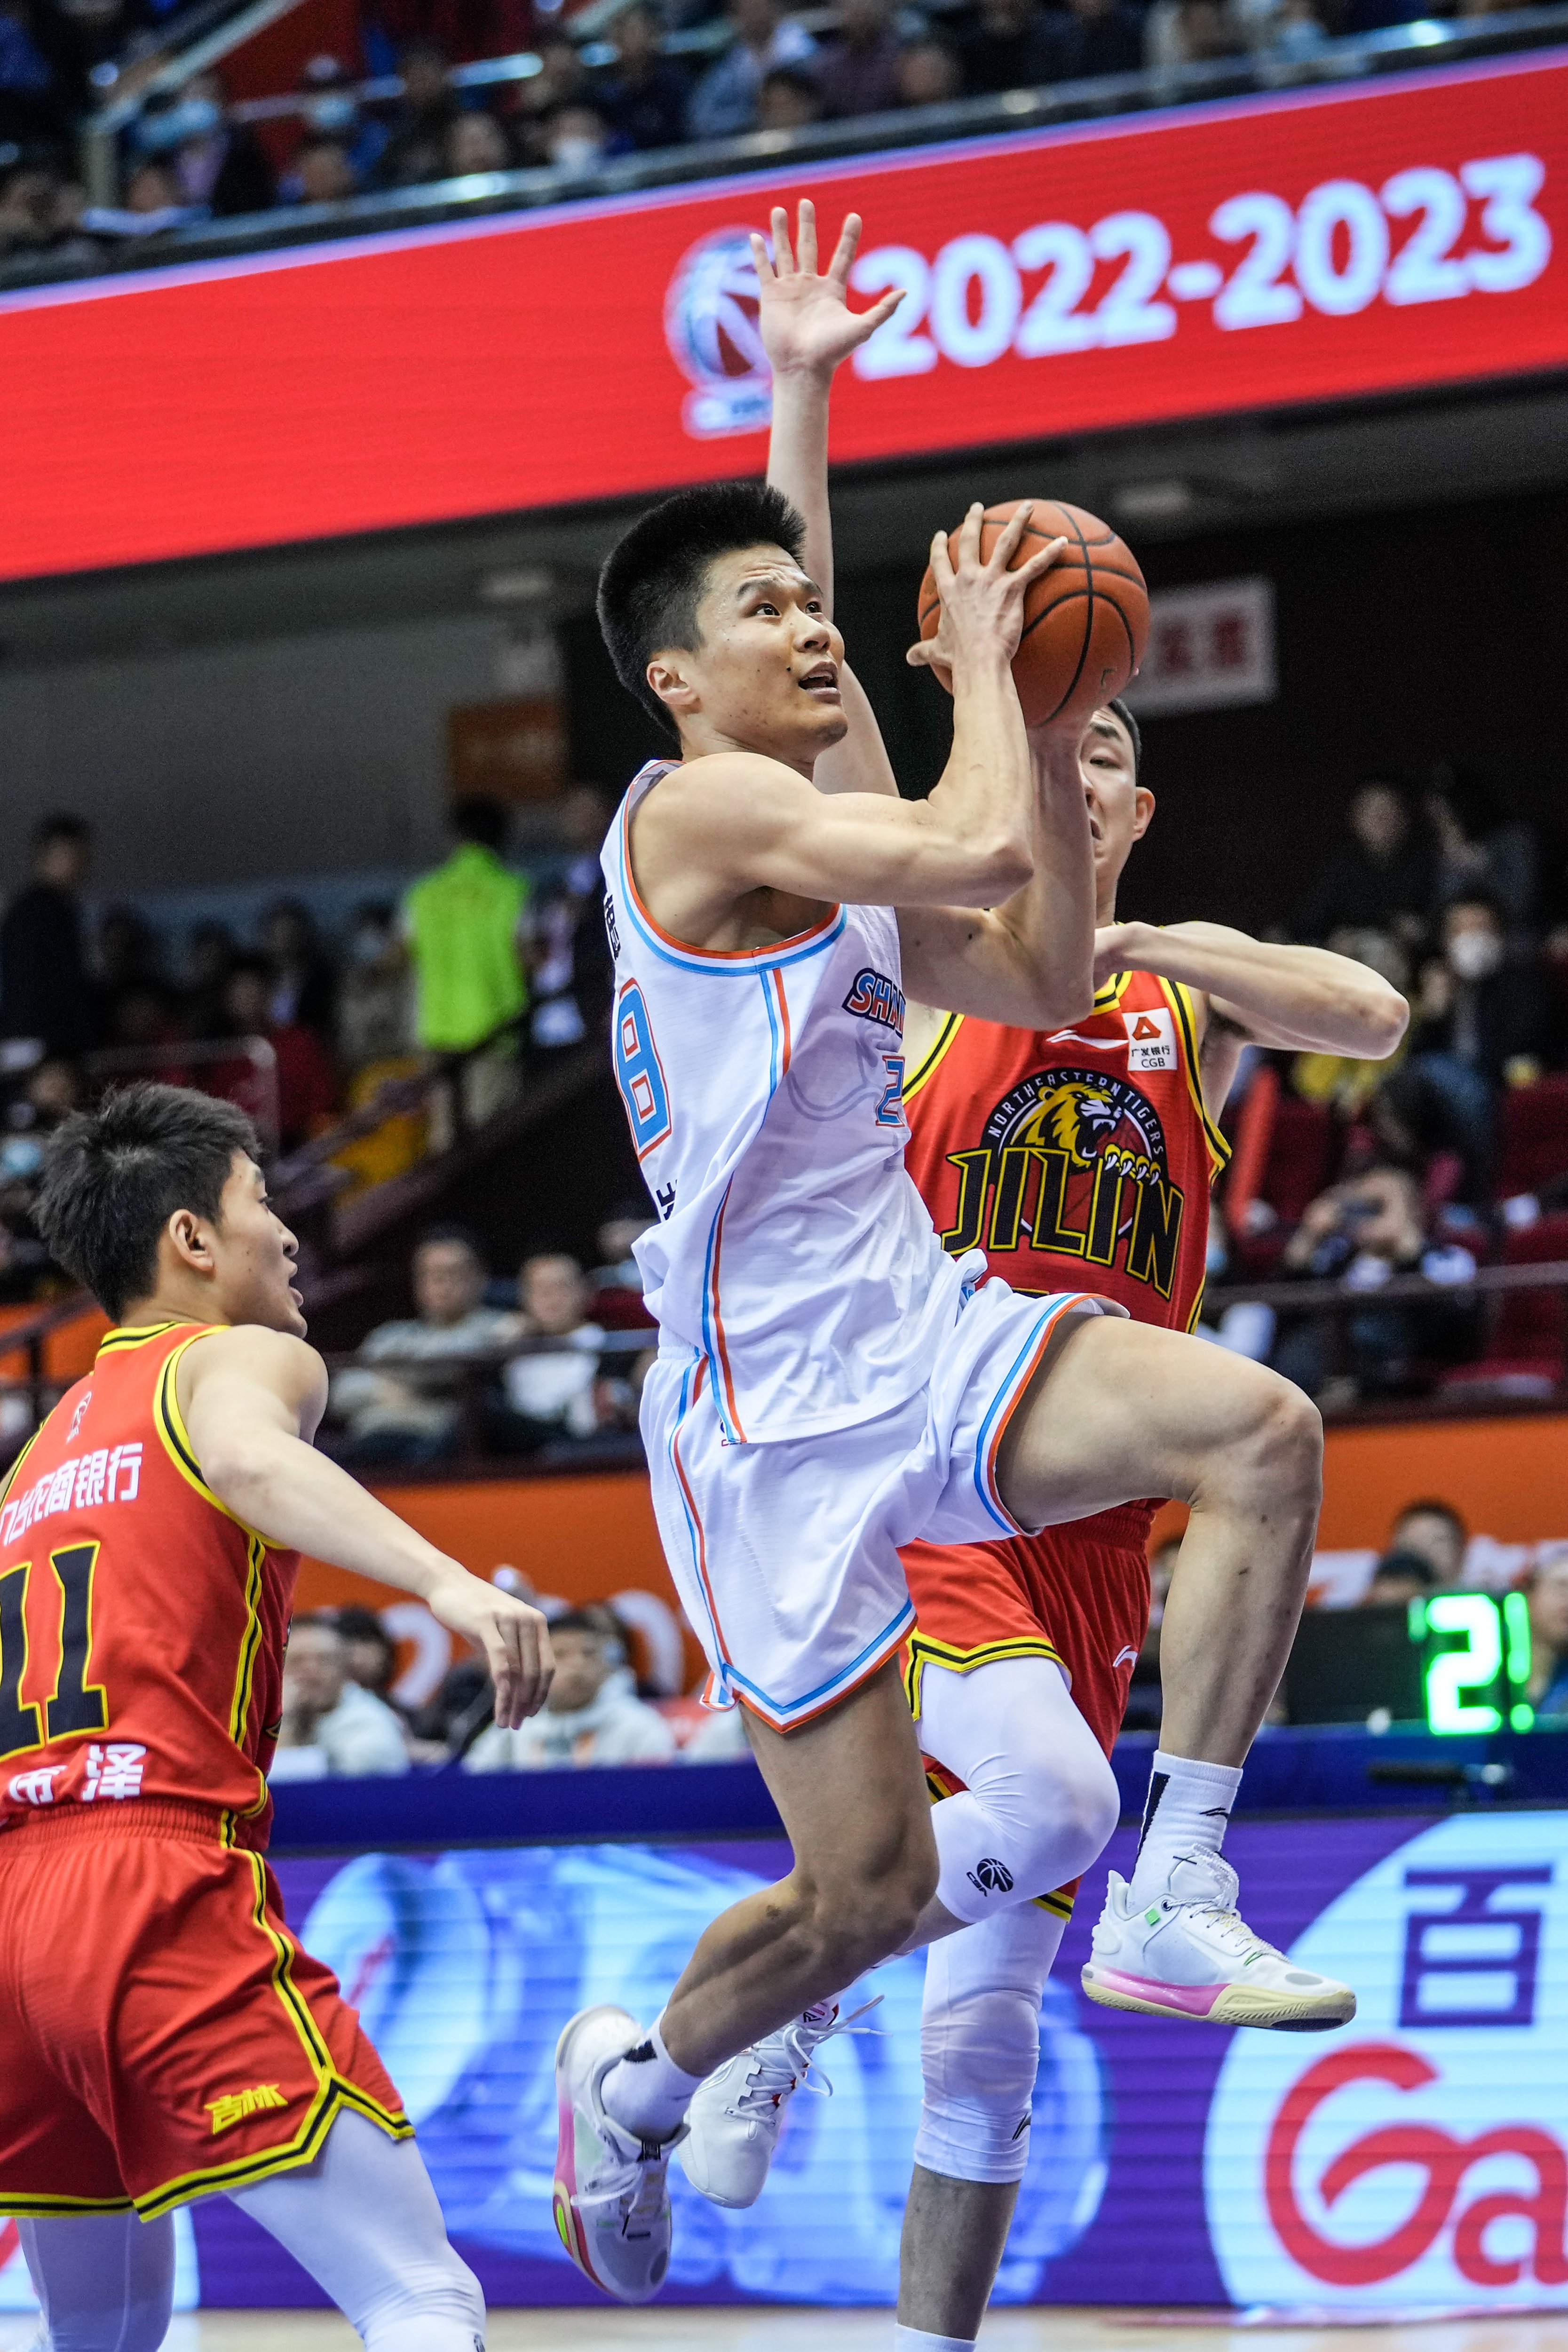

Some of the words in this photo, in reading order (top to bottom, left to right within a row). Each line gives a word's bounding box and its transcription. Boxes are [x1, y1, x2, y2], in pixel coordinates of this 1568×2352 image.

[850, 151, 1551, 381] 2022-2023
[1132, 1045, 1170, 1057] 广发银行
[1141, 1057, 1165, 1068] CGB
[989, 1071, 1122, 1137] NORTHEASTERN
[1124, 1090, 1164, 1155] TIGERS
[939, 1146, 1184, 1301] JILIN
[0, 1541, 109, 1762] 11
[1398, 1864, 1553, 2027] 百
[204, 2083, 288, 2135] 吉林
